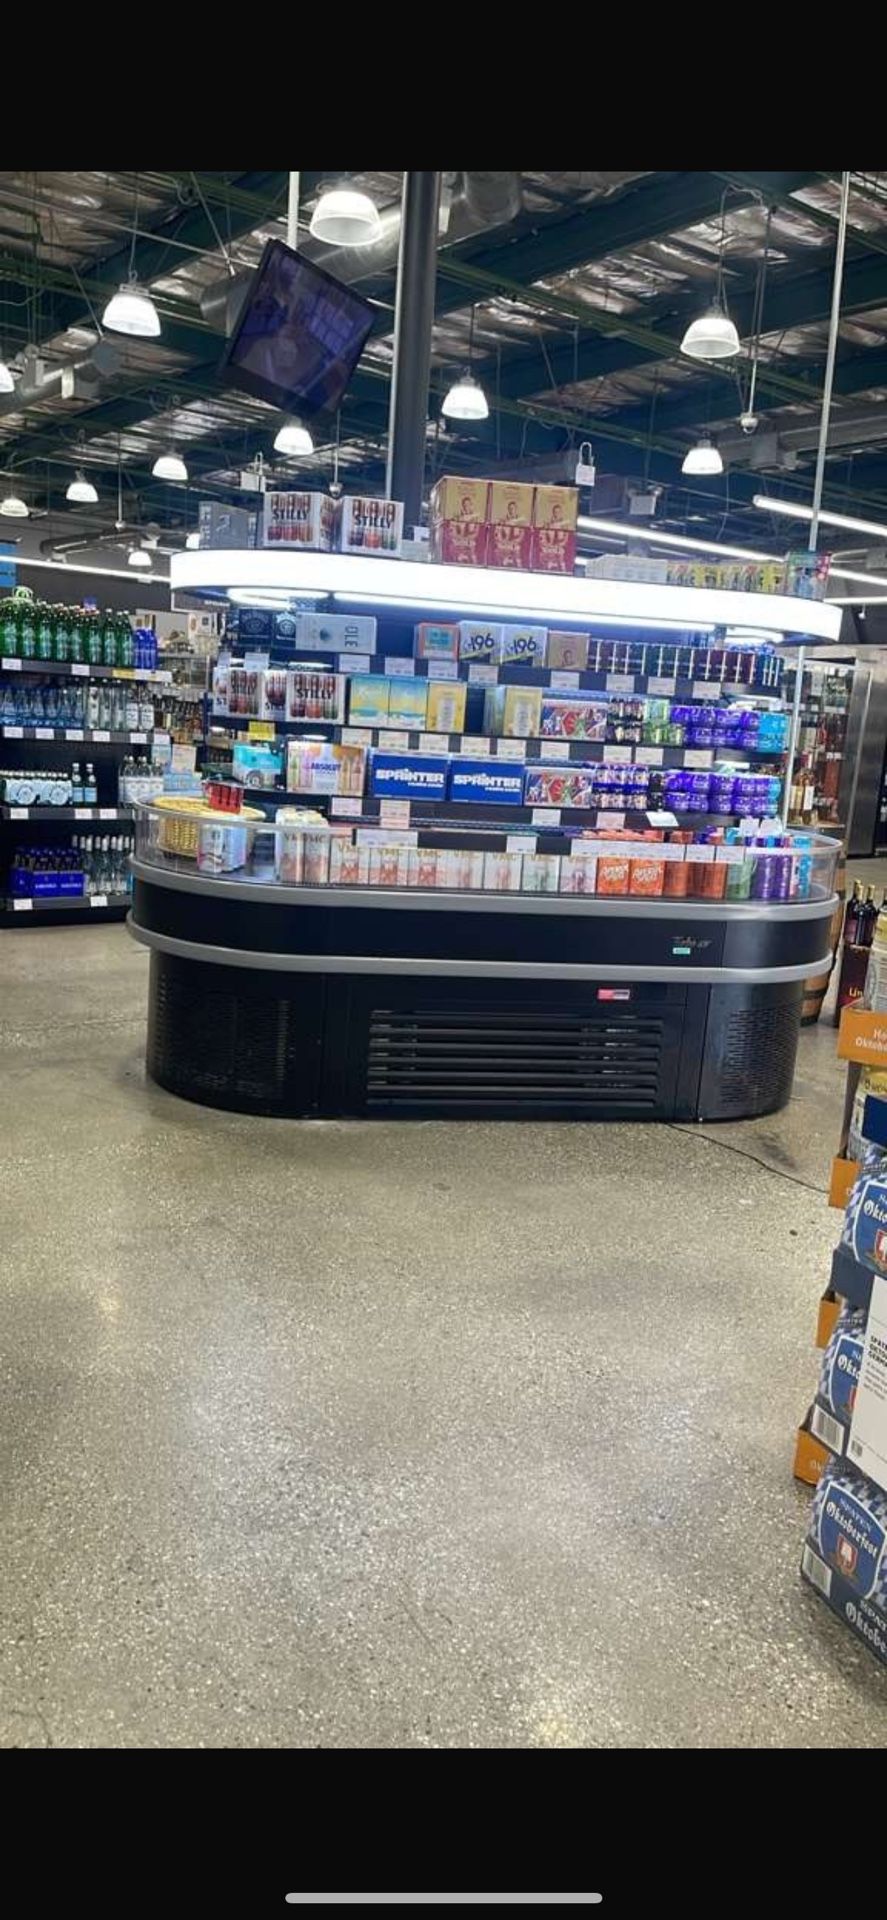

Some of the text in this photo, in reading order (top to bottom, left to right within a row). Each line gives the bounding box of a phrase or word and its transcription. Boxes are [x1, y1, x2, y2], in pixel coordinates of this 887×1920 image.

[272, 508, 310, 521] STILLY
[354, 513, 393, 529] STILLY
[296, 688, 334, 700] STILLY
[375, 768, 444, 784] SPRINTER
[453, 773, 521, 788] SPRINTER
[826, 1501, 878, 1557] Oktoberfest
